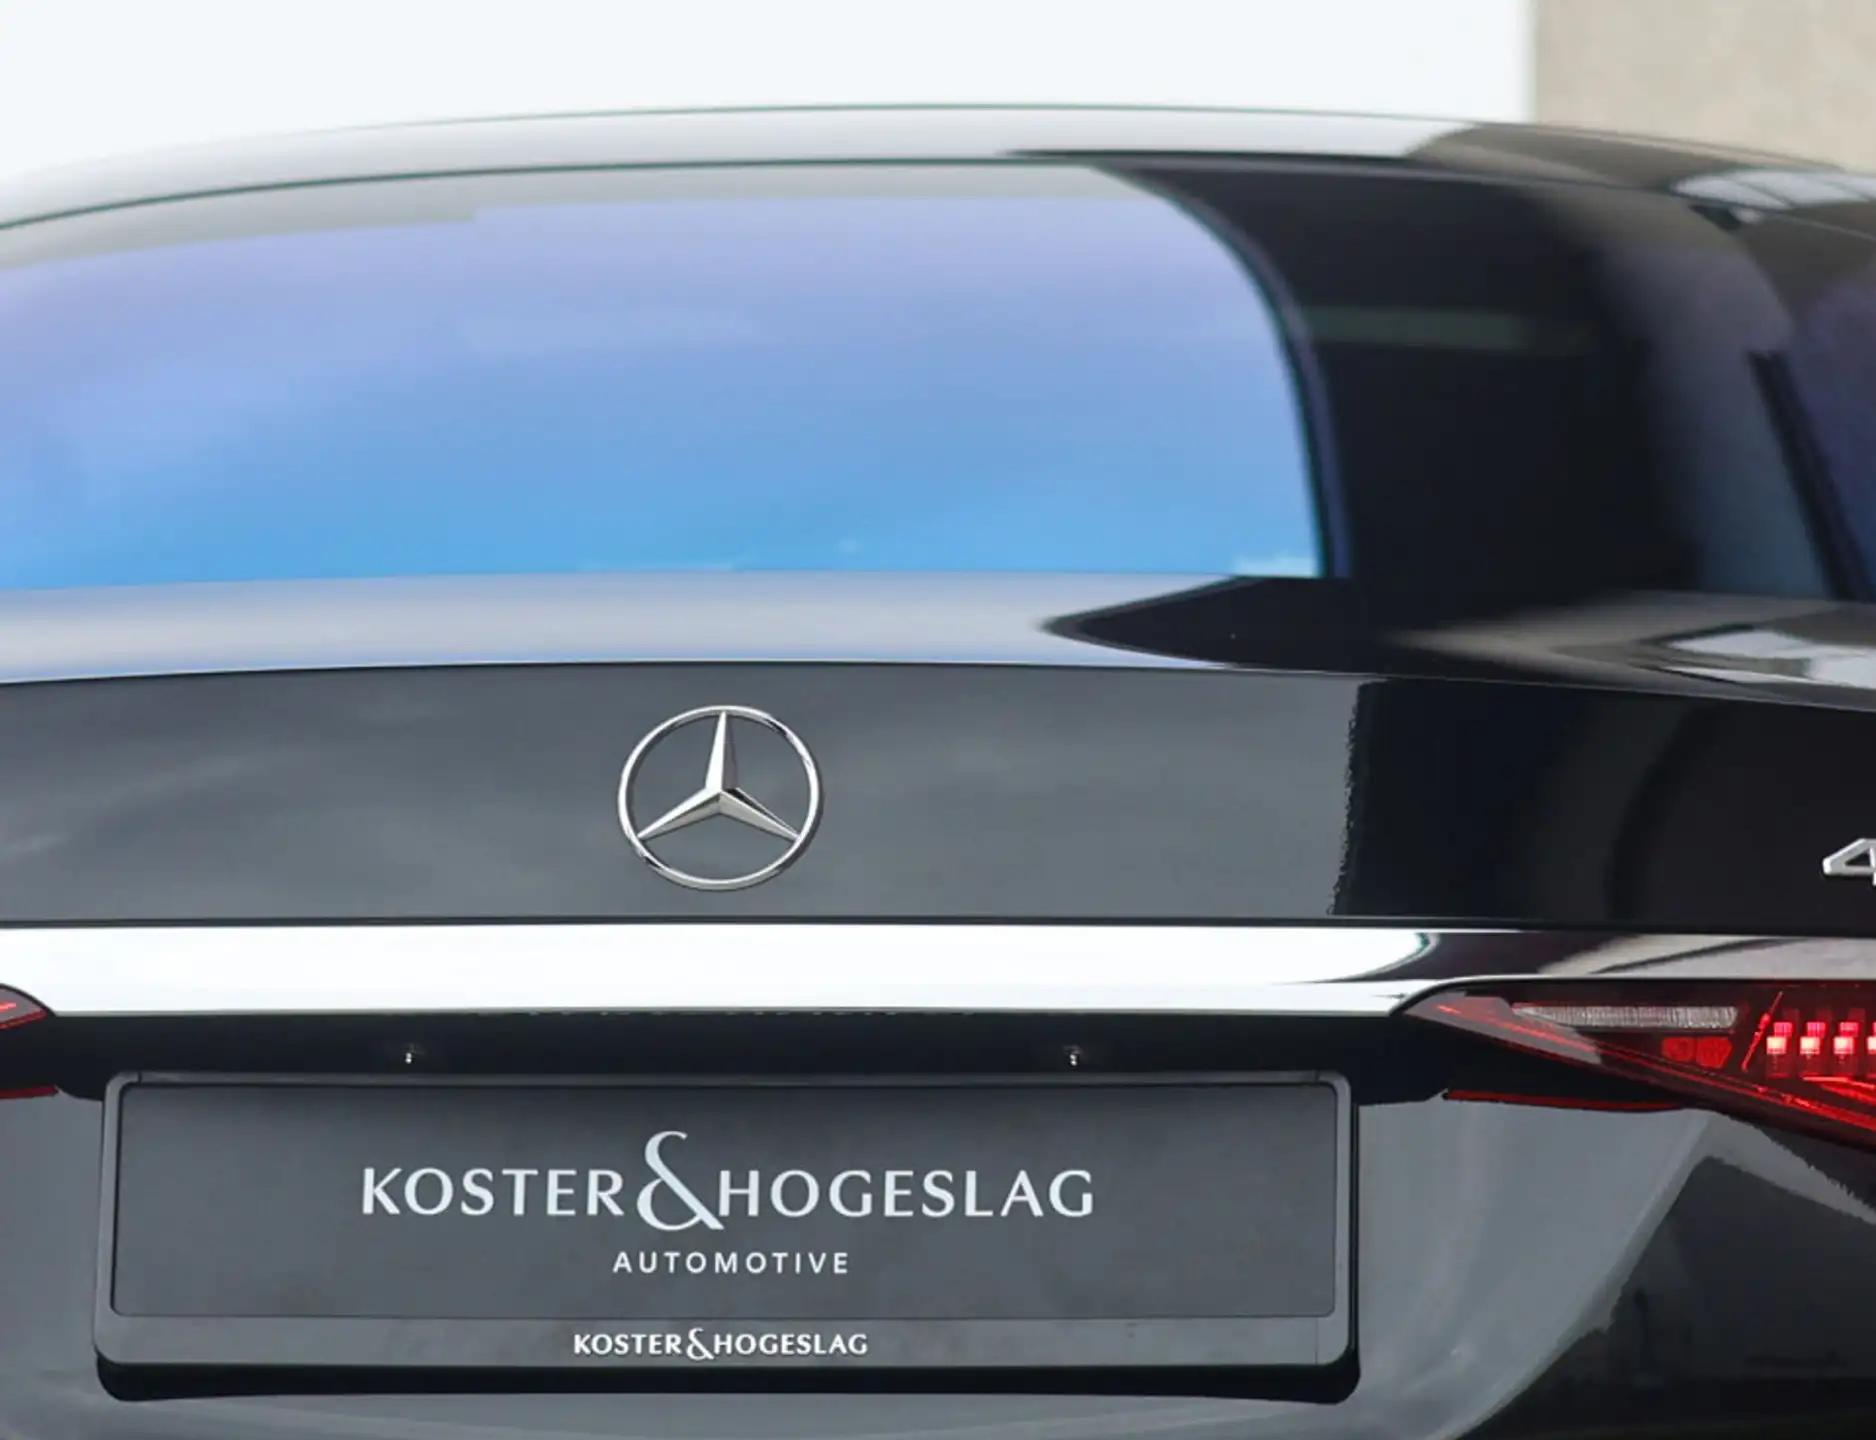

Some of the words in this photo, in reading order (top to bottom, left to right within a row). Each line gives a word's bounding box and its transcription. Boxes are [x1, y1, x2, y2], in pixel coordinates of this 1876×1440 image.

[361, 1130, 1094, 1231] KOSTER&HOGESLAG
[612, 1250, 849, 1275] AUTOMOTIVE
[573, 1327, 869, 1361] KOSTER&HOGESLAG
